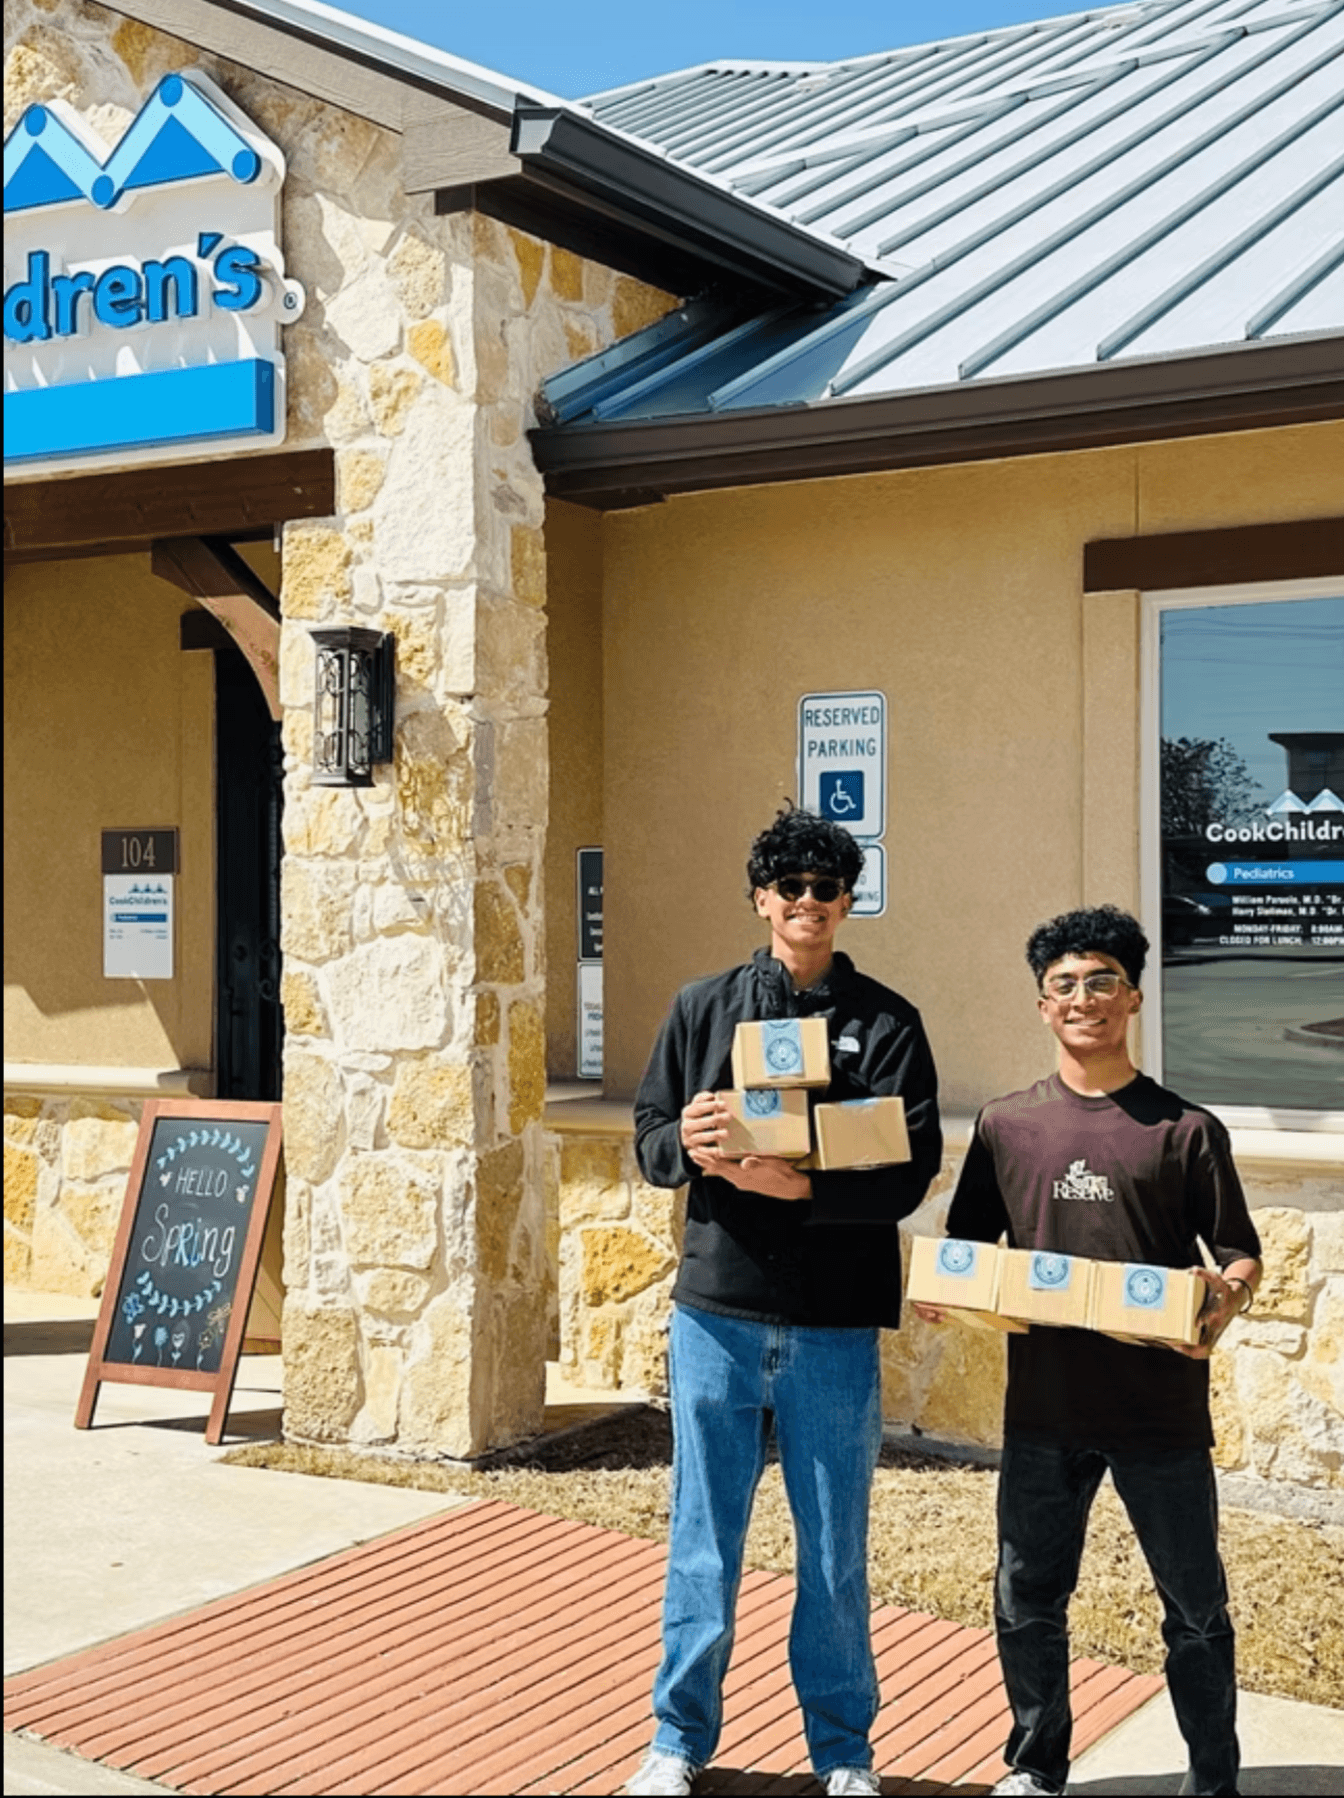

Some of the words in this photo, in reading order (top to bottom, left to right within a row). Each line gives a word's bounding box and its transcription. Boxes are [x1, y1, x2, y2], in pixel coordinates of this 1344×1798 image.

[4, 231, 262, 343] dren's
[805, 706, 880, 727] RESERVED
[807, 738, 877, 757] PARKING
[1205, 820, 1344, 842] CookChildr
[121, 836, 156, 868] 104
[1233, 867, 1294, 880] Pediatrics
[1253, 935, 1270, 945] FOR
[175, 1167, 228, 1198] HELLO
